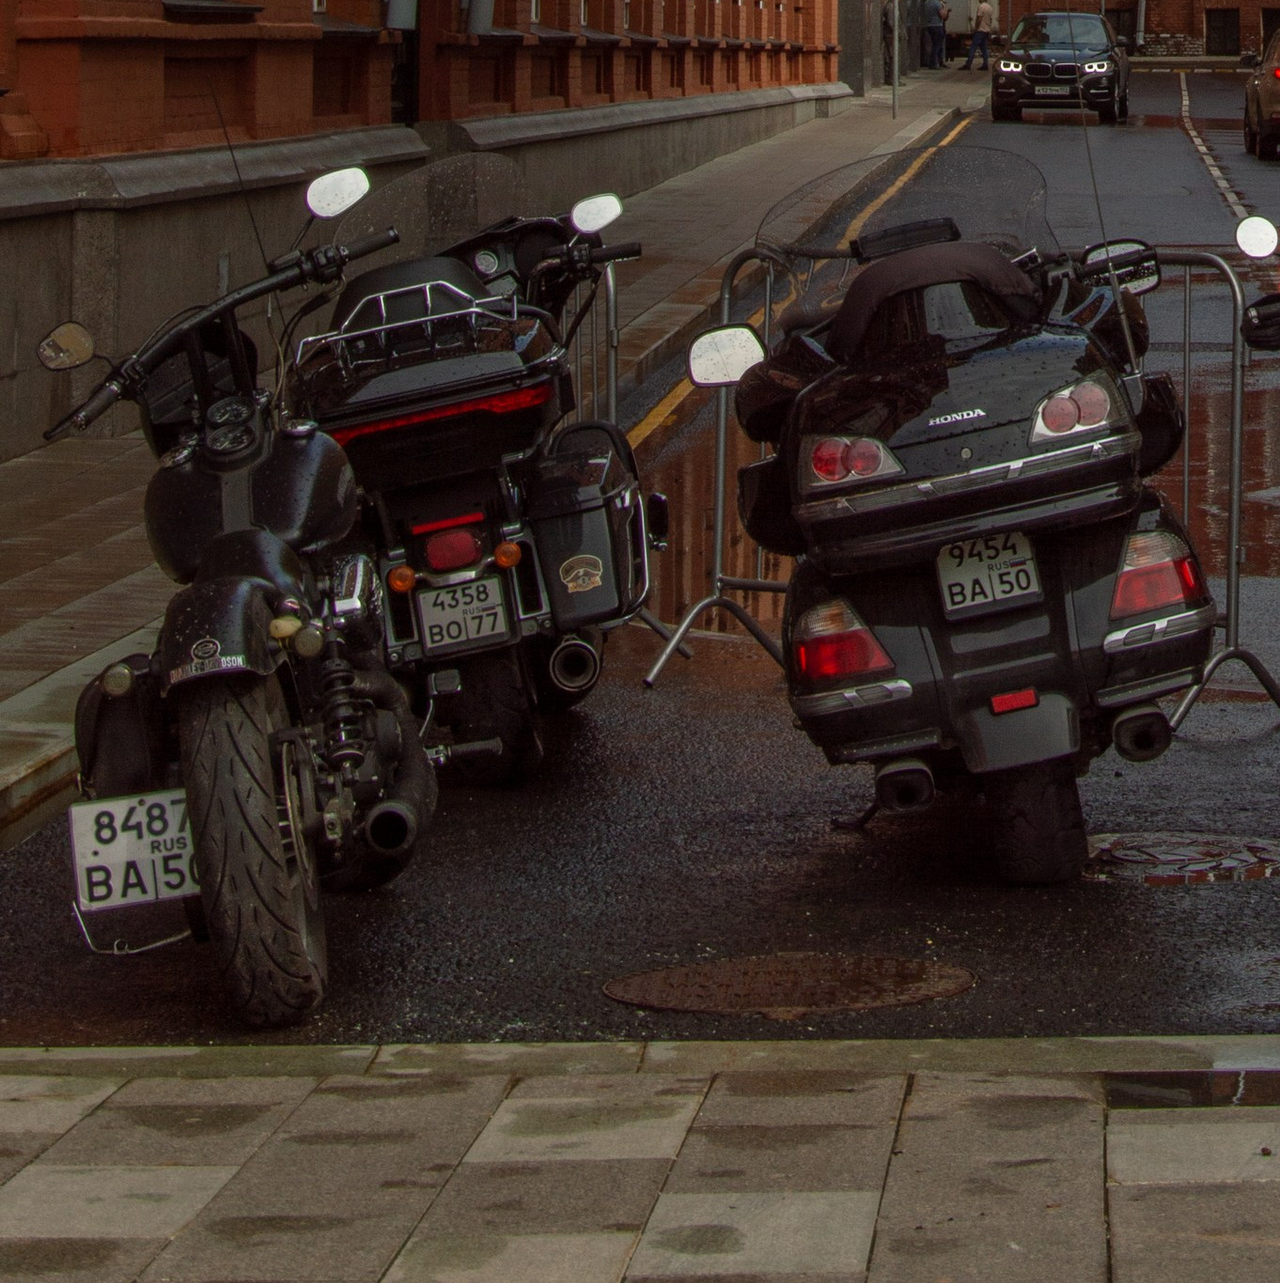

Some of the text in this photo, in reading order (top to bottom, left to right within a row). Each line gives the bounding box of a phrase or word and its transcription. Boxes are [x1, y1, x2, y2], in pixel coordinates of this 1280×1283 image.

[929, 408, 986, 426] HONDA
[949, 534, 1017, 568] 9454
[987, 562, 1009, 572] RUS
[999, 569, 1030, 595] 50
[432, 584, 489, 611] 4358
[462, 607, 481, 616] RUS
[471, 612, 498, 635] 77
[94, 798, 188, 844] 8487
[151, 837, 187, 854] RUS
